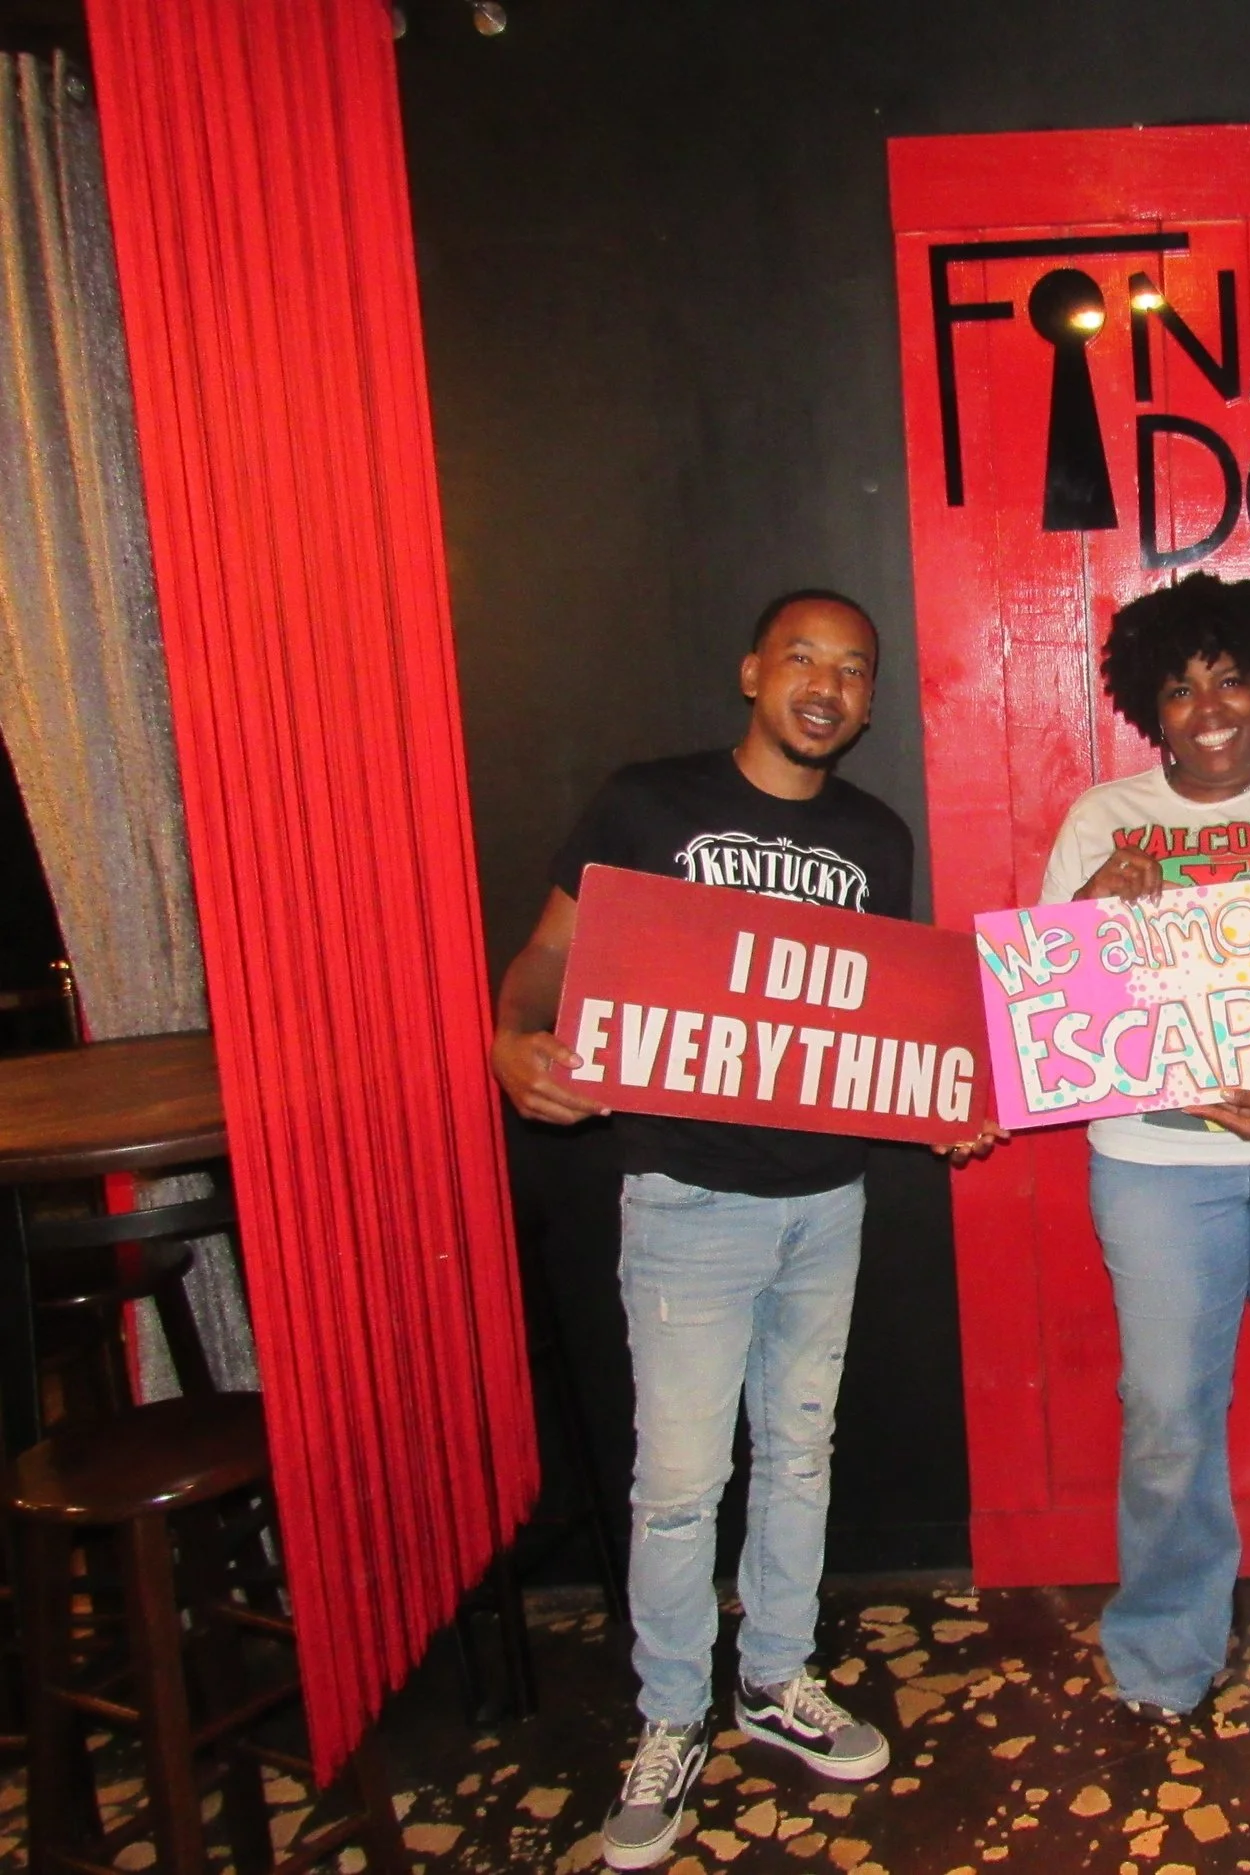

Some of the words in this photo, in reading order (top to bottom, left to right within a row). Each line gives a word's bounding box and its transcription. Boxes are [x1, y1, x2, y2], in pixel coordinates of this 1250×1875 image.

[699, 847, 858, 907] KENTUCKY
[728, 931, 756, 994] I
[765, 936, 869, 1011] DID
[976, 909, 1080, 998] We
[571, 998, 975, 1123] EVERYTHING
